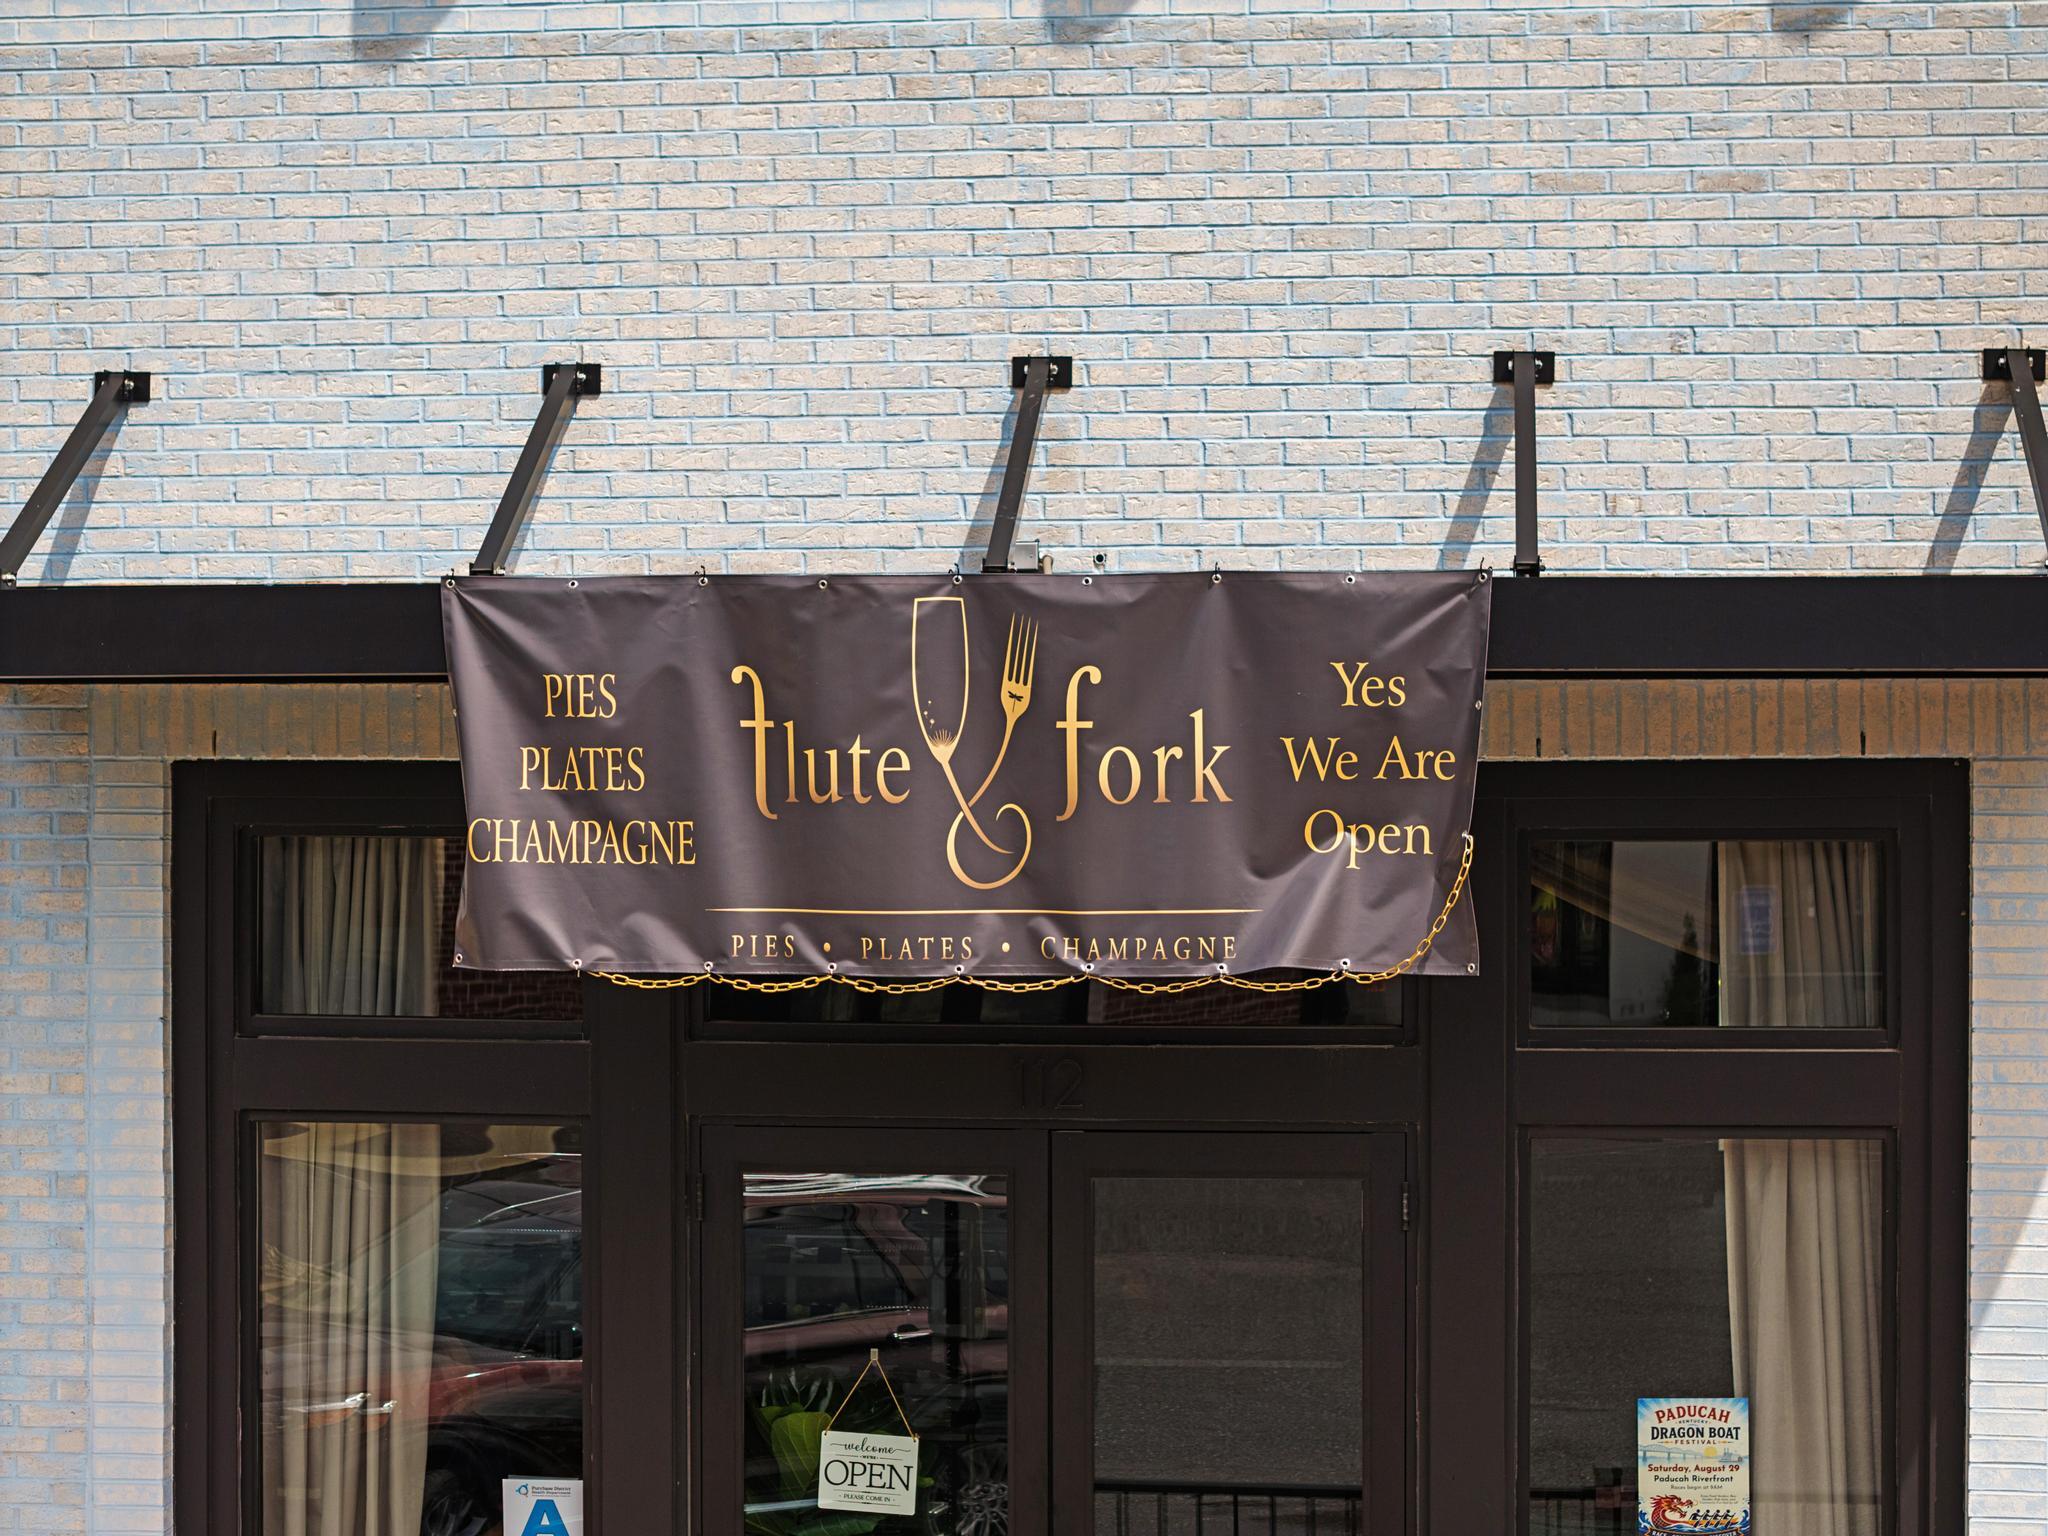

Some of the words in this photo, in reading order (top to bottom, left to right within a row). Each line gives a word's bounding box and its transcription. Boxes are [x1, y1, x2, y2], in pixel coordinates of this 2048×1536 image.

[543, 673, 617, 719] PIES
[1330, 661, 1406, 708] Yes
[730, 664, 911, 821] flute
[1056, 664, 1233, 822] fork
[1280, 736, 1359, 783] We
[1373, 735, 1457, 782] Are
[520, 746, 646, 793] PLATES
[468, 818, 697, 866] CHAMPAGNE
[1303, 808, 1434, 870] Open
[731, 934, 797, 959] PIES
[860, 935, 974, 962] PLATES
[1041, 935, 1238, 962] CHAMPAGNE
[1011, 1056, 1085, 1111] 112
[1651, 1427, 1704, 1440] DRAGON
[1709, 1427, 1740, 1440] BOAT
[1655, 1406, 1731, 1424] PADUCAH
[836, 1437, 904, 1454] welcome
[824, 1459, 914, 1491] OPEN
[1648, 1464, 1691, 1473] Saturday,
[1694, 1465, 1725, 1473] August
[1728, 1464, 1740, 1472] 29
[1654, 1474, 1689, 1482] Paducah
[1692, 1474, 1734, 1482] Riverfront
[865, 1494, 883, 1502] COME
[521, 1499, 570, 1536] A
